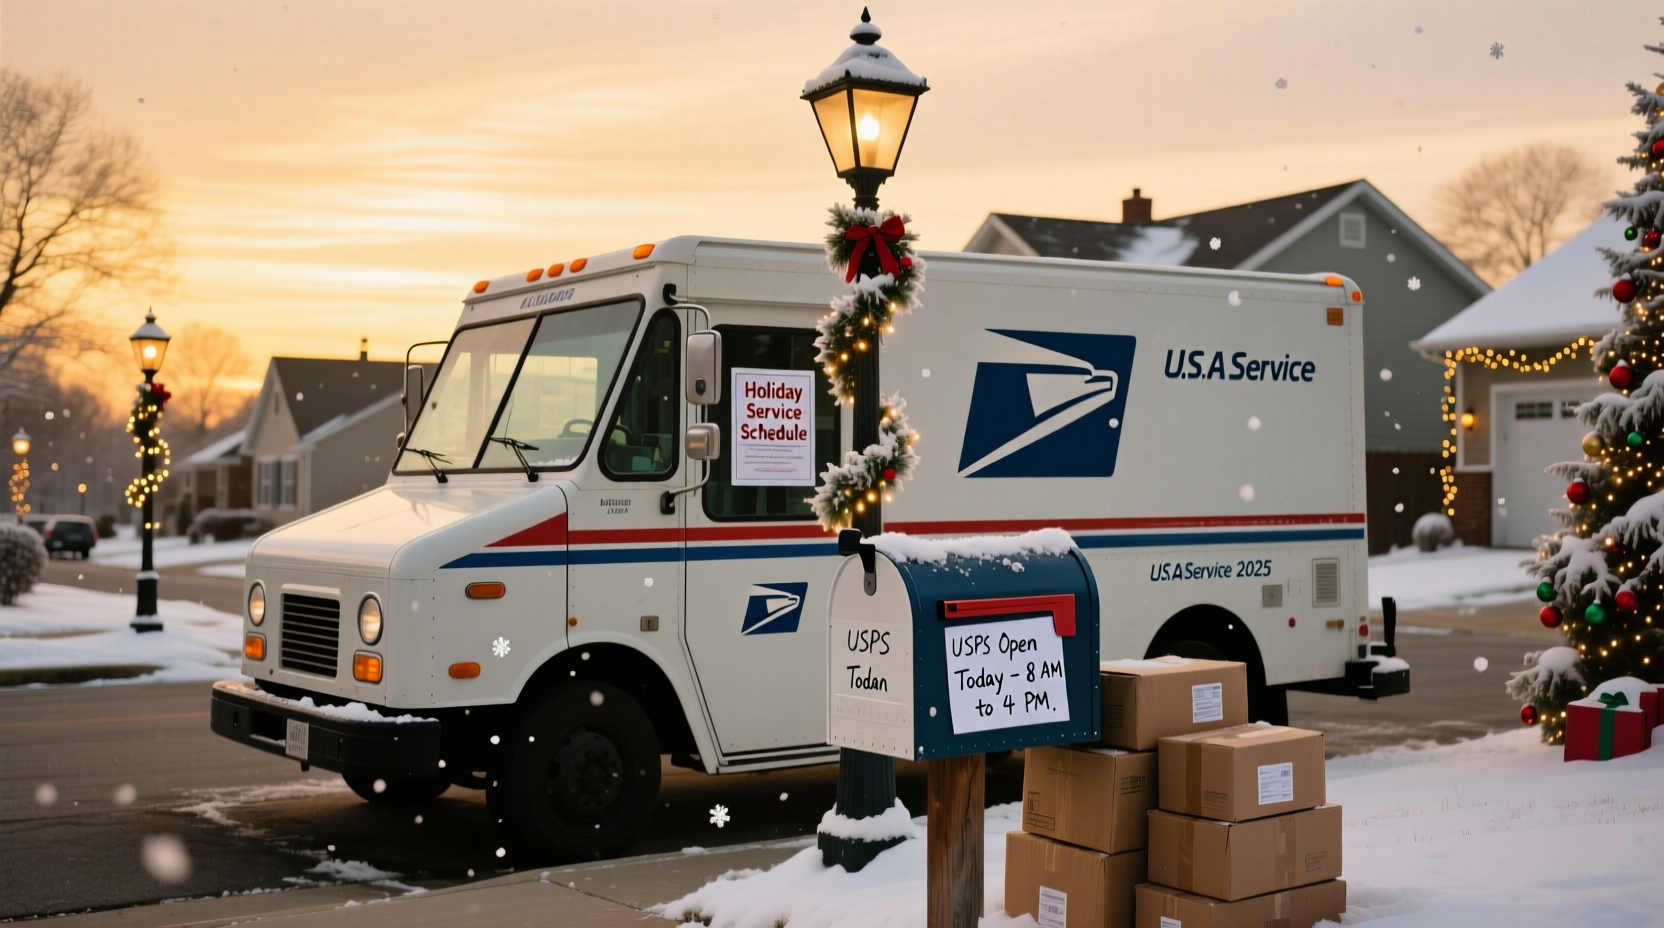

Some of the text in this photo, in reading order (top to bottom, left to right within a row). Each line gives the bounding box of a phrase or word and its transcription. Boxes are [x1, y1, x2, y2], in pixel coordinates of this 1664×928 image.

[745, 381, 803, 404] Holiday
[746, 402, 802, 420] Service
[741, 423, 807, 441] Schedule
[1236, 559, 1272, 578] 2025
[847, 629, 890, 655] USPS
[952, 632, 1037, 661] USPS Open
[954, 668, 1004, 695] Today
[1026, 661, 1036, 683] 8
[1040, 660, 1063, 679] AM
[975, 691, 1057, 717] to 4 PM.
